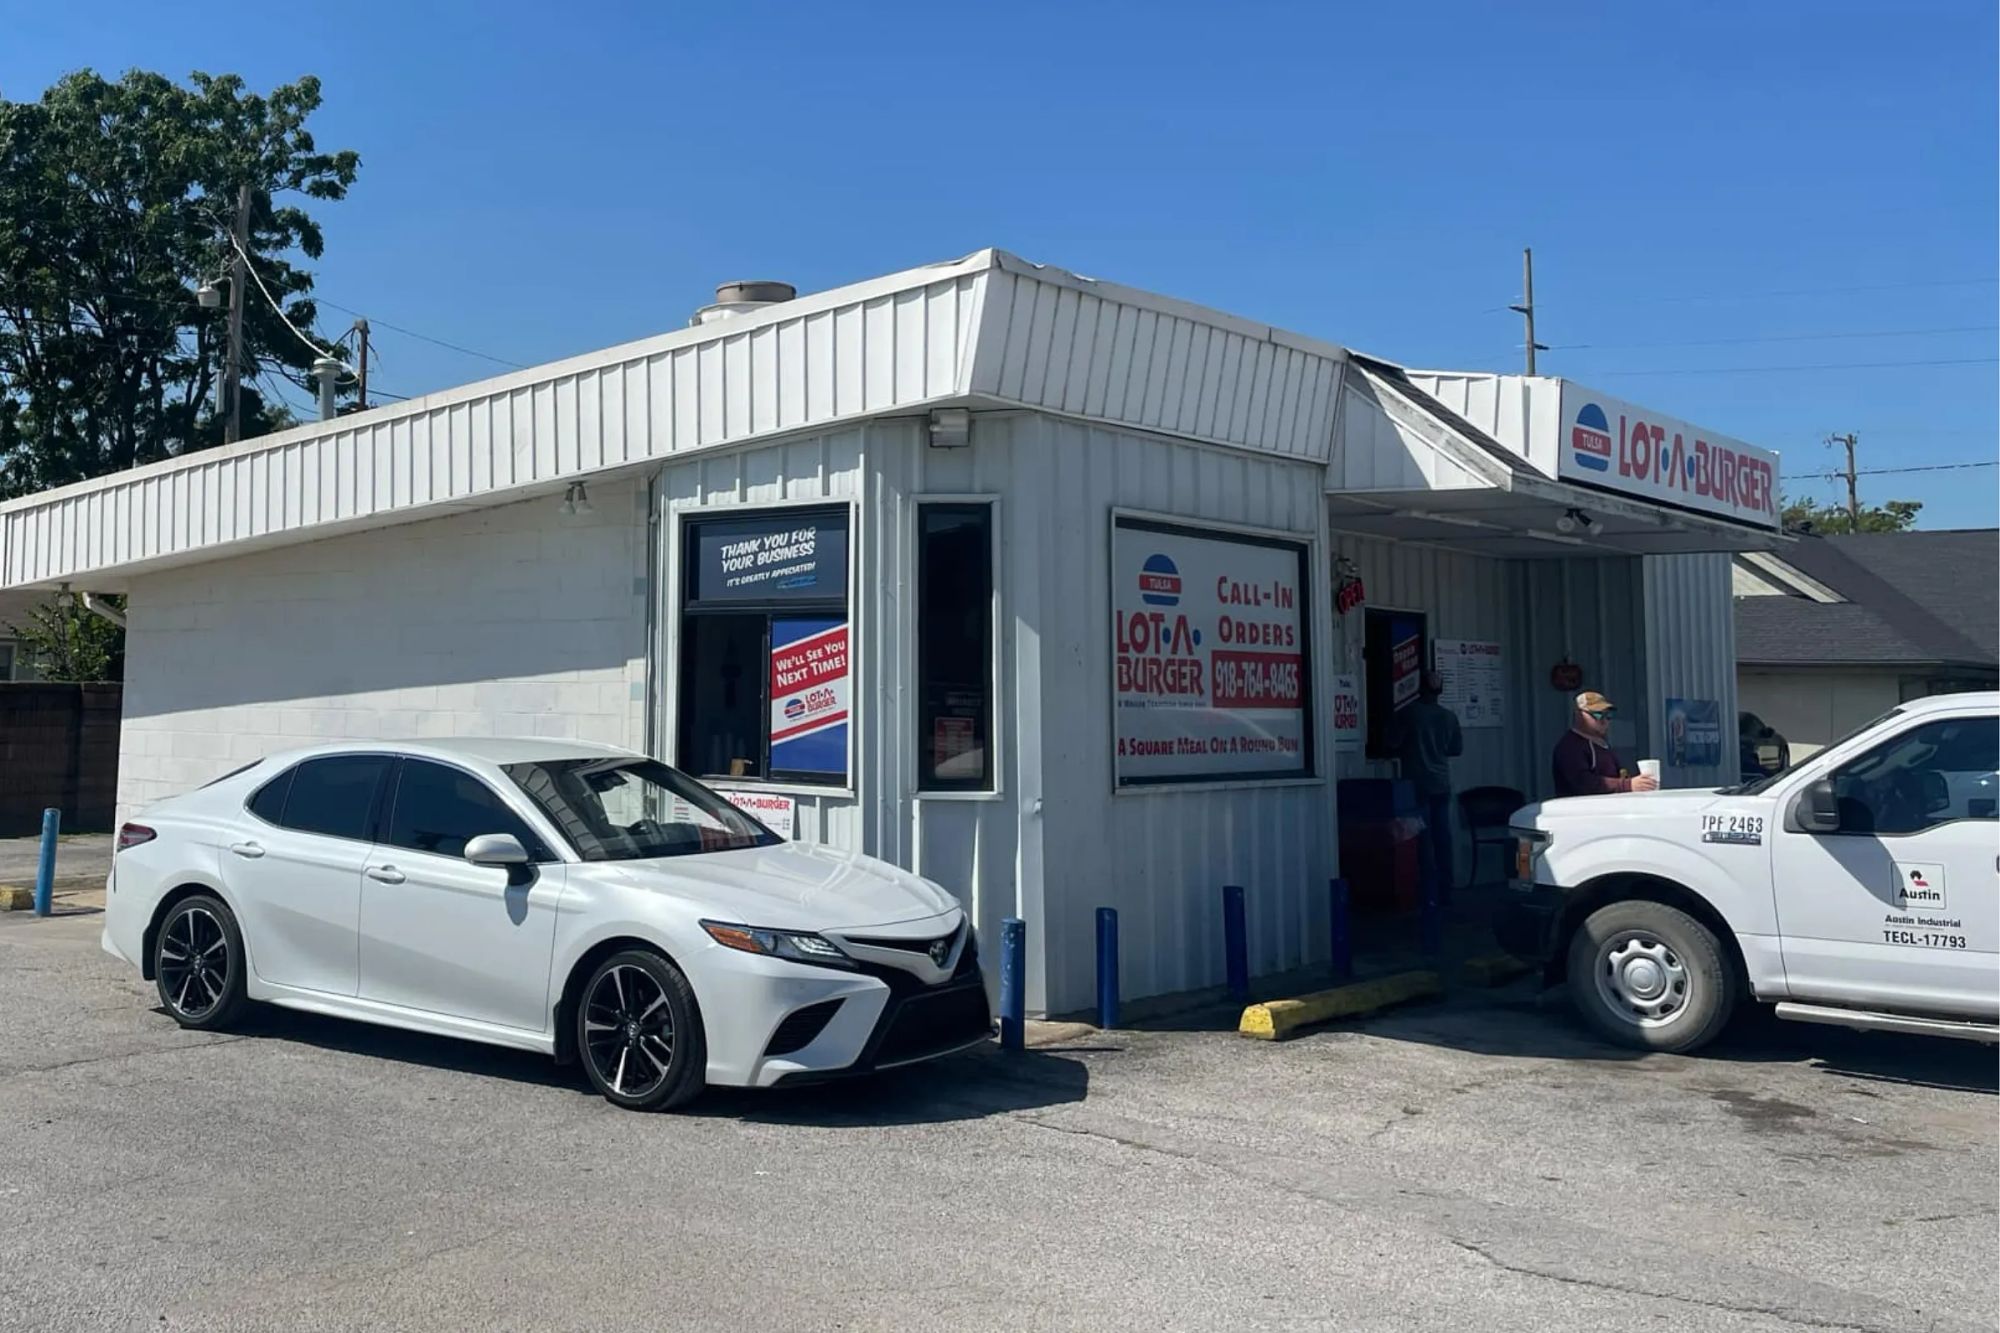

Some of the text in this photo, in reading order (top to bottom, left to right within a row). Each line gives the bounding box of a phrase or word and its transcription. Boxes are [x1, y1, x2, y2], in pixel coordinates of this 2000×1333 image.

[720, 526, 816, 559] THANK YOU FOR
[721, 541, 815, 573] YOUR BUSINESS
[726, 576, 741, 588] IT'S
[741, 571, 770, 585] GREATLY
[1217, 575, 1293, 609] CALL-IN
[1218, 615, 1295, 647] ORDERS
[776, 640, 845, 672] WE'LL SEE YOU
[776, 654, 846, 688] NEXT TIME!
[1116, 655, 1204, 697] BURGER
[1215, 660, 1298, 699] 918-764-8465
[807, 695, 837, 713] BURGER
[1118, 735, 1298, 756] A SQUARE MEAL ON A ROUND BUN
[1729, 816, 1763, 833] 2463
[1899, 888, 1941, 901] Austin
[1885, 914, 1914, 924] Austin
[1917, 916, 1961, 928] Industrial
[1883, 930, 1966, 949] TECL-17793
